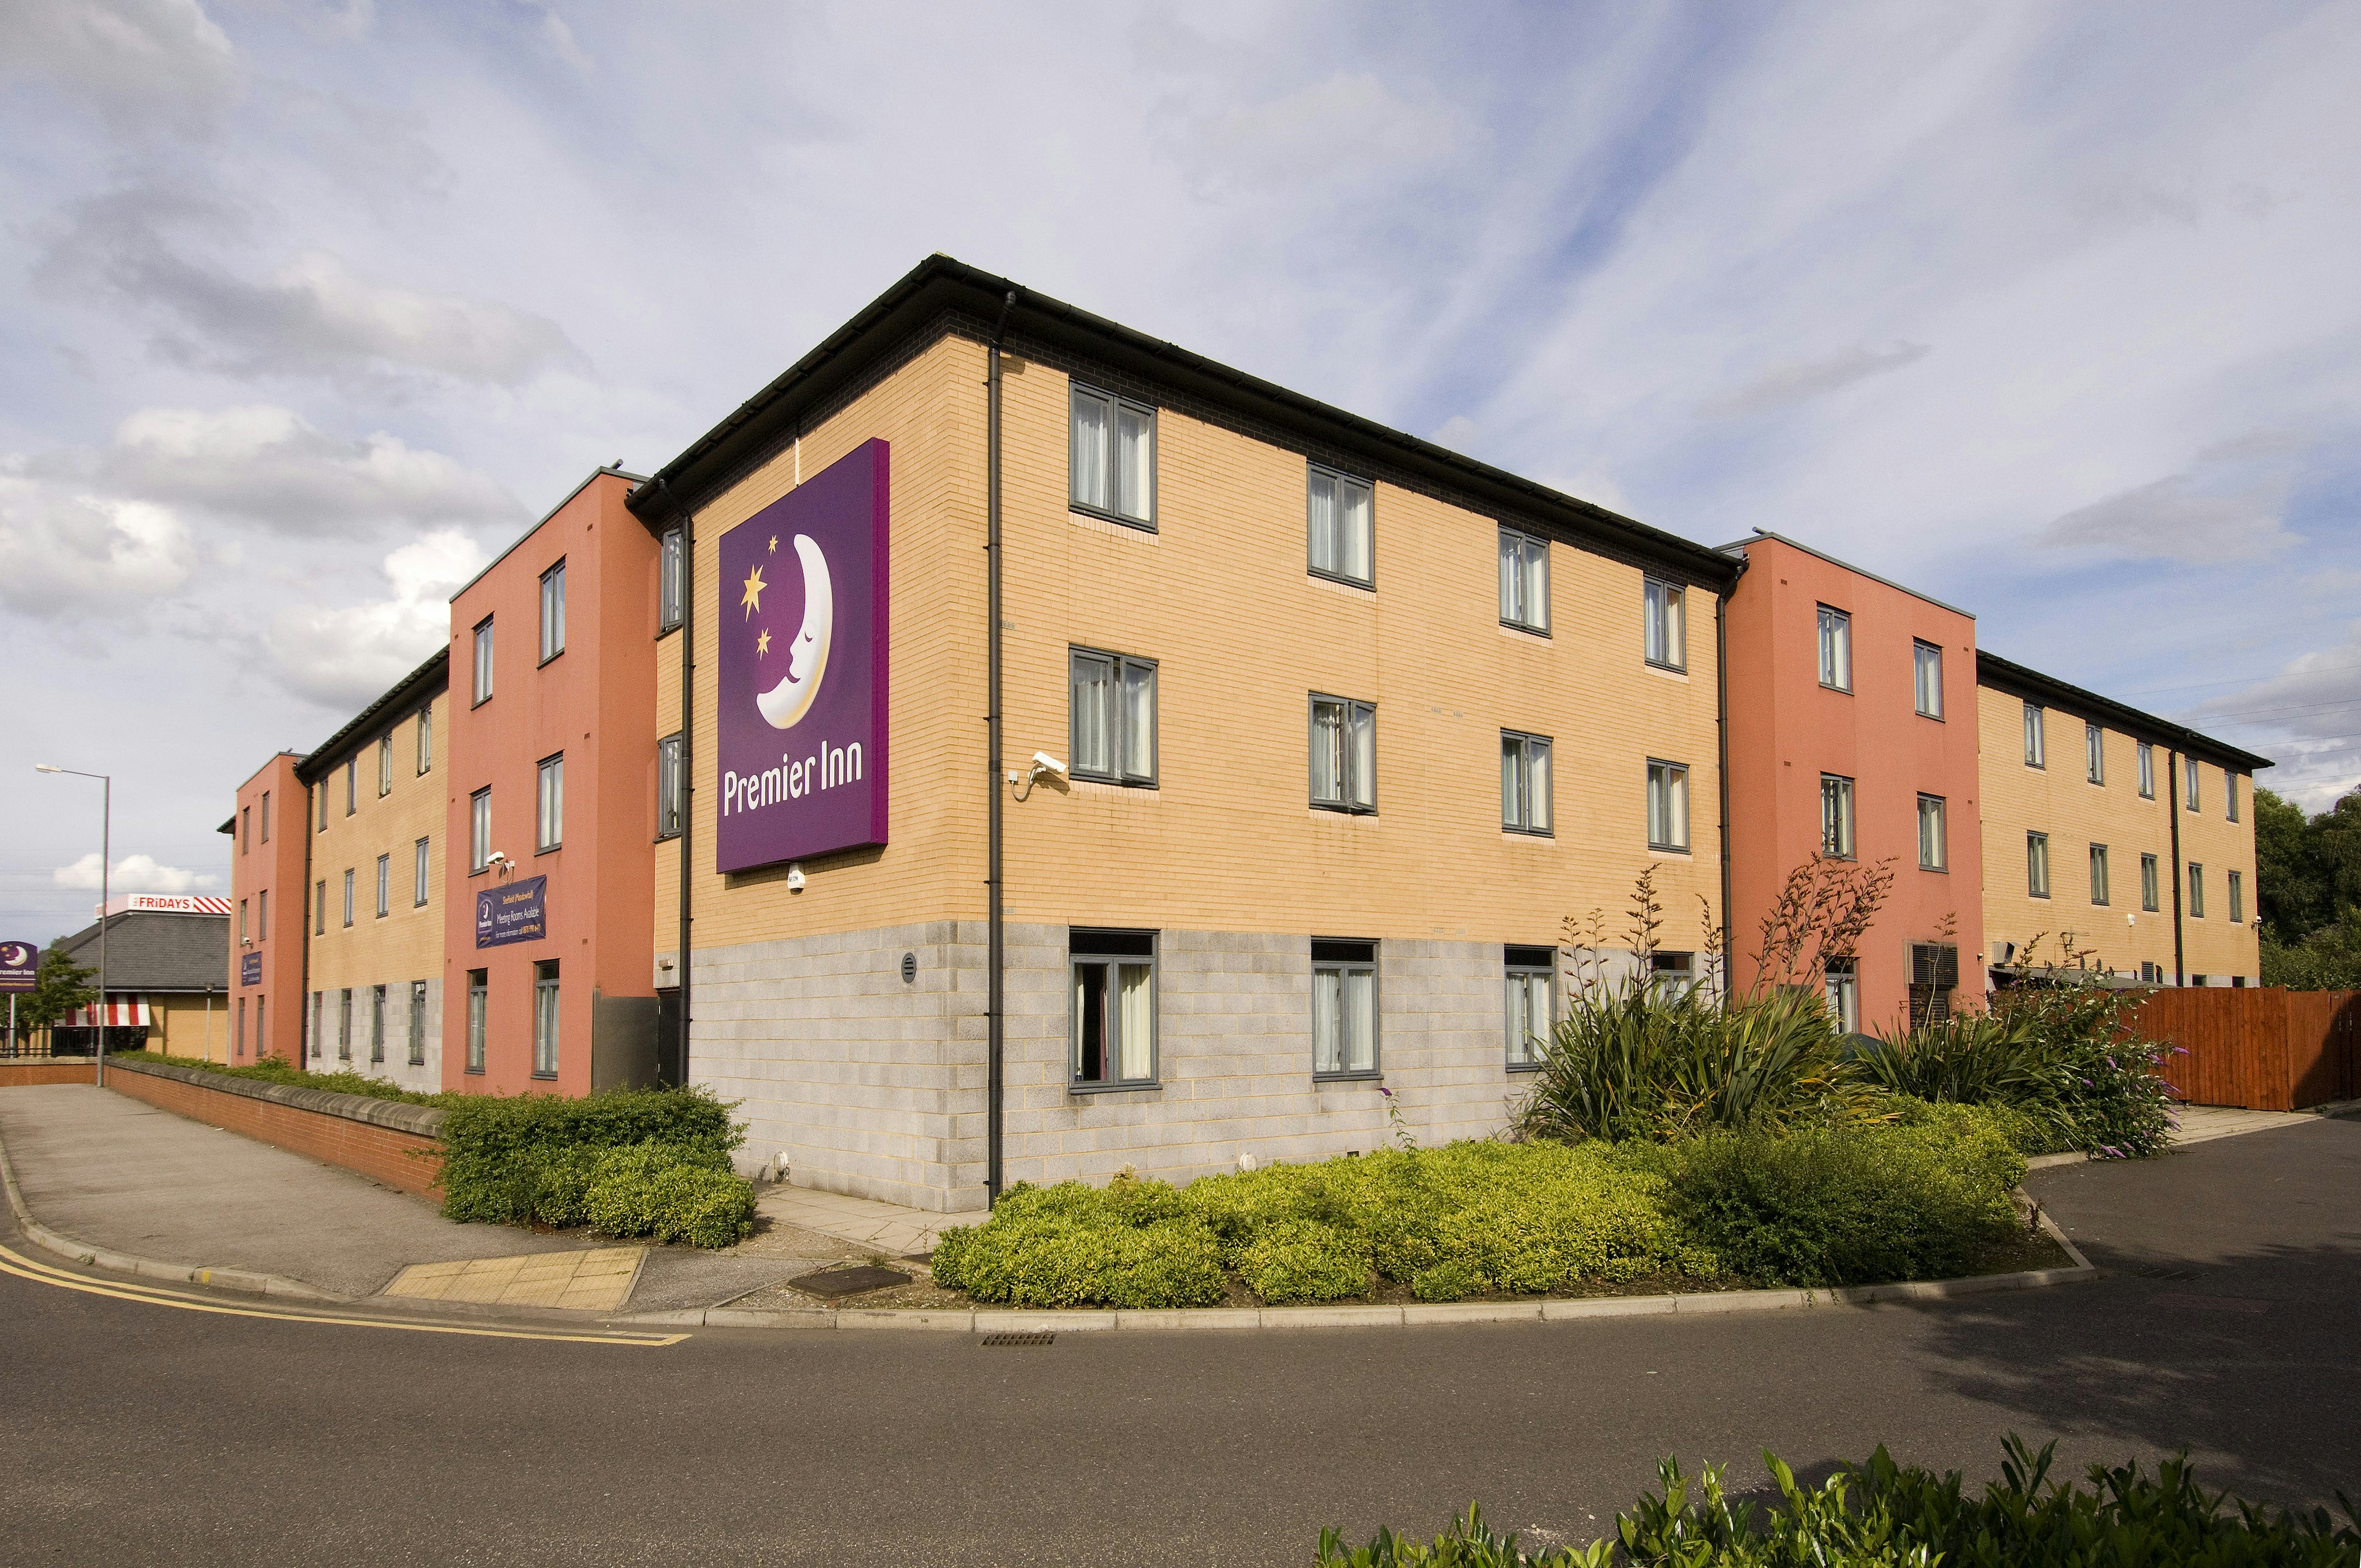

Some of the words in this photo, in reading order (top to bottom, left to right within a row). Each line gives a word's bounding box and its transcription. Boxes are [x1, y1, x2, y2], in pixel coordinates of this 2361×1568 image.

[723, 753, 816, 817] Premier
[821, 739, 862, 791] Inn
[497, 912, 510, 925] Meeting
[510, 910, 523, 922] Rooms
[523, 906, 539, 919] Available
